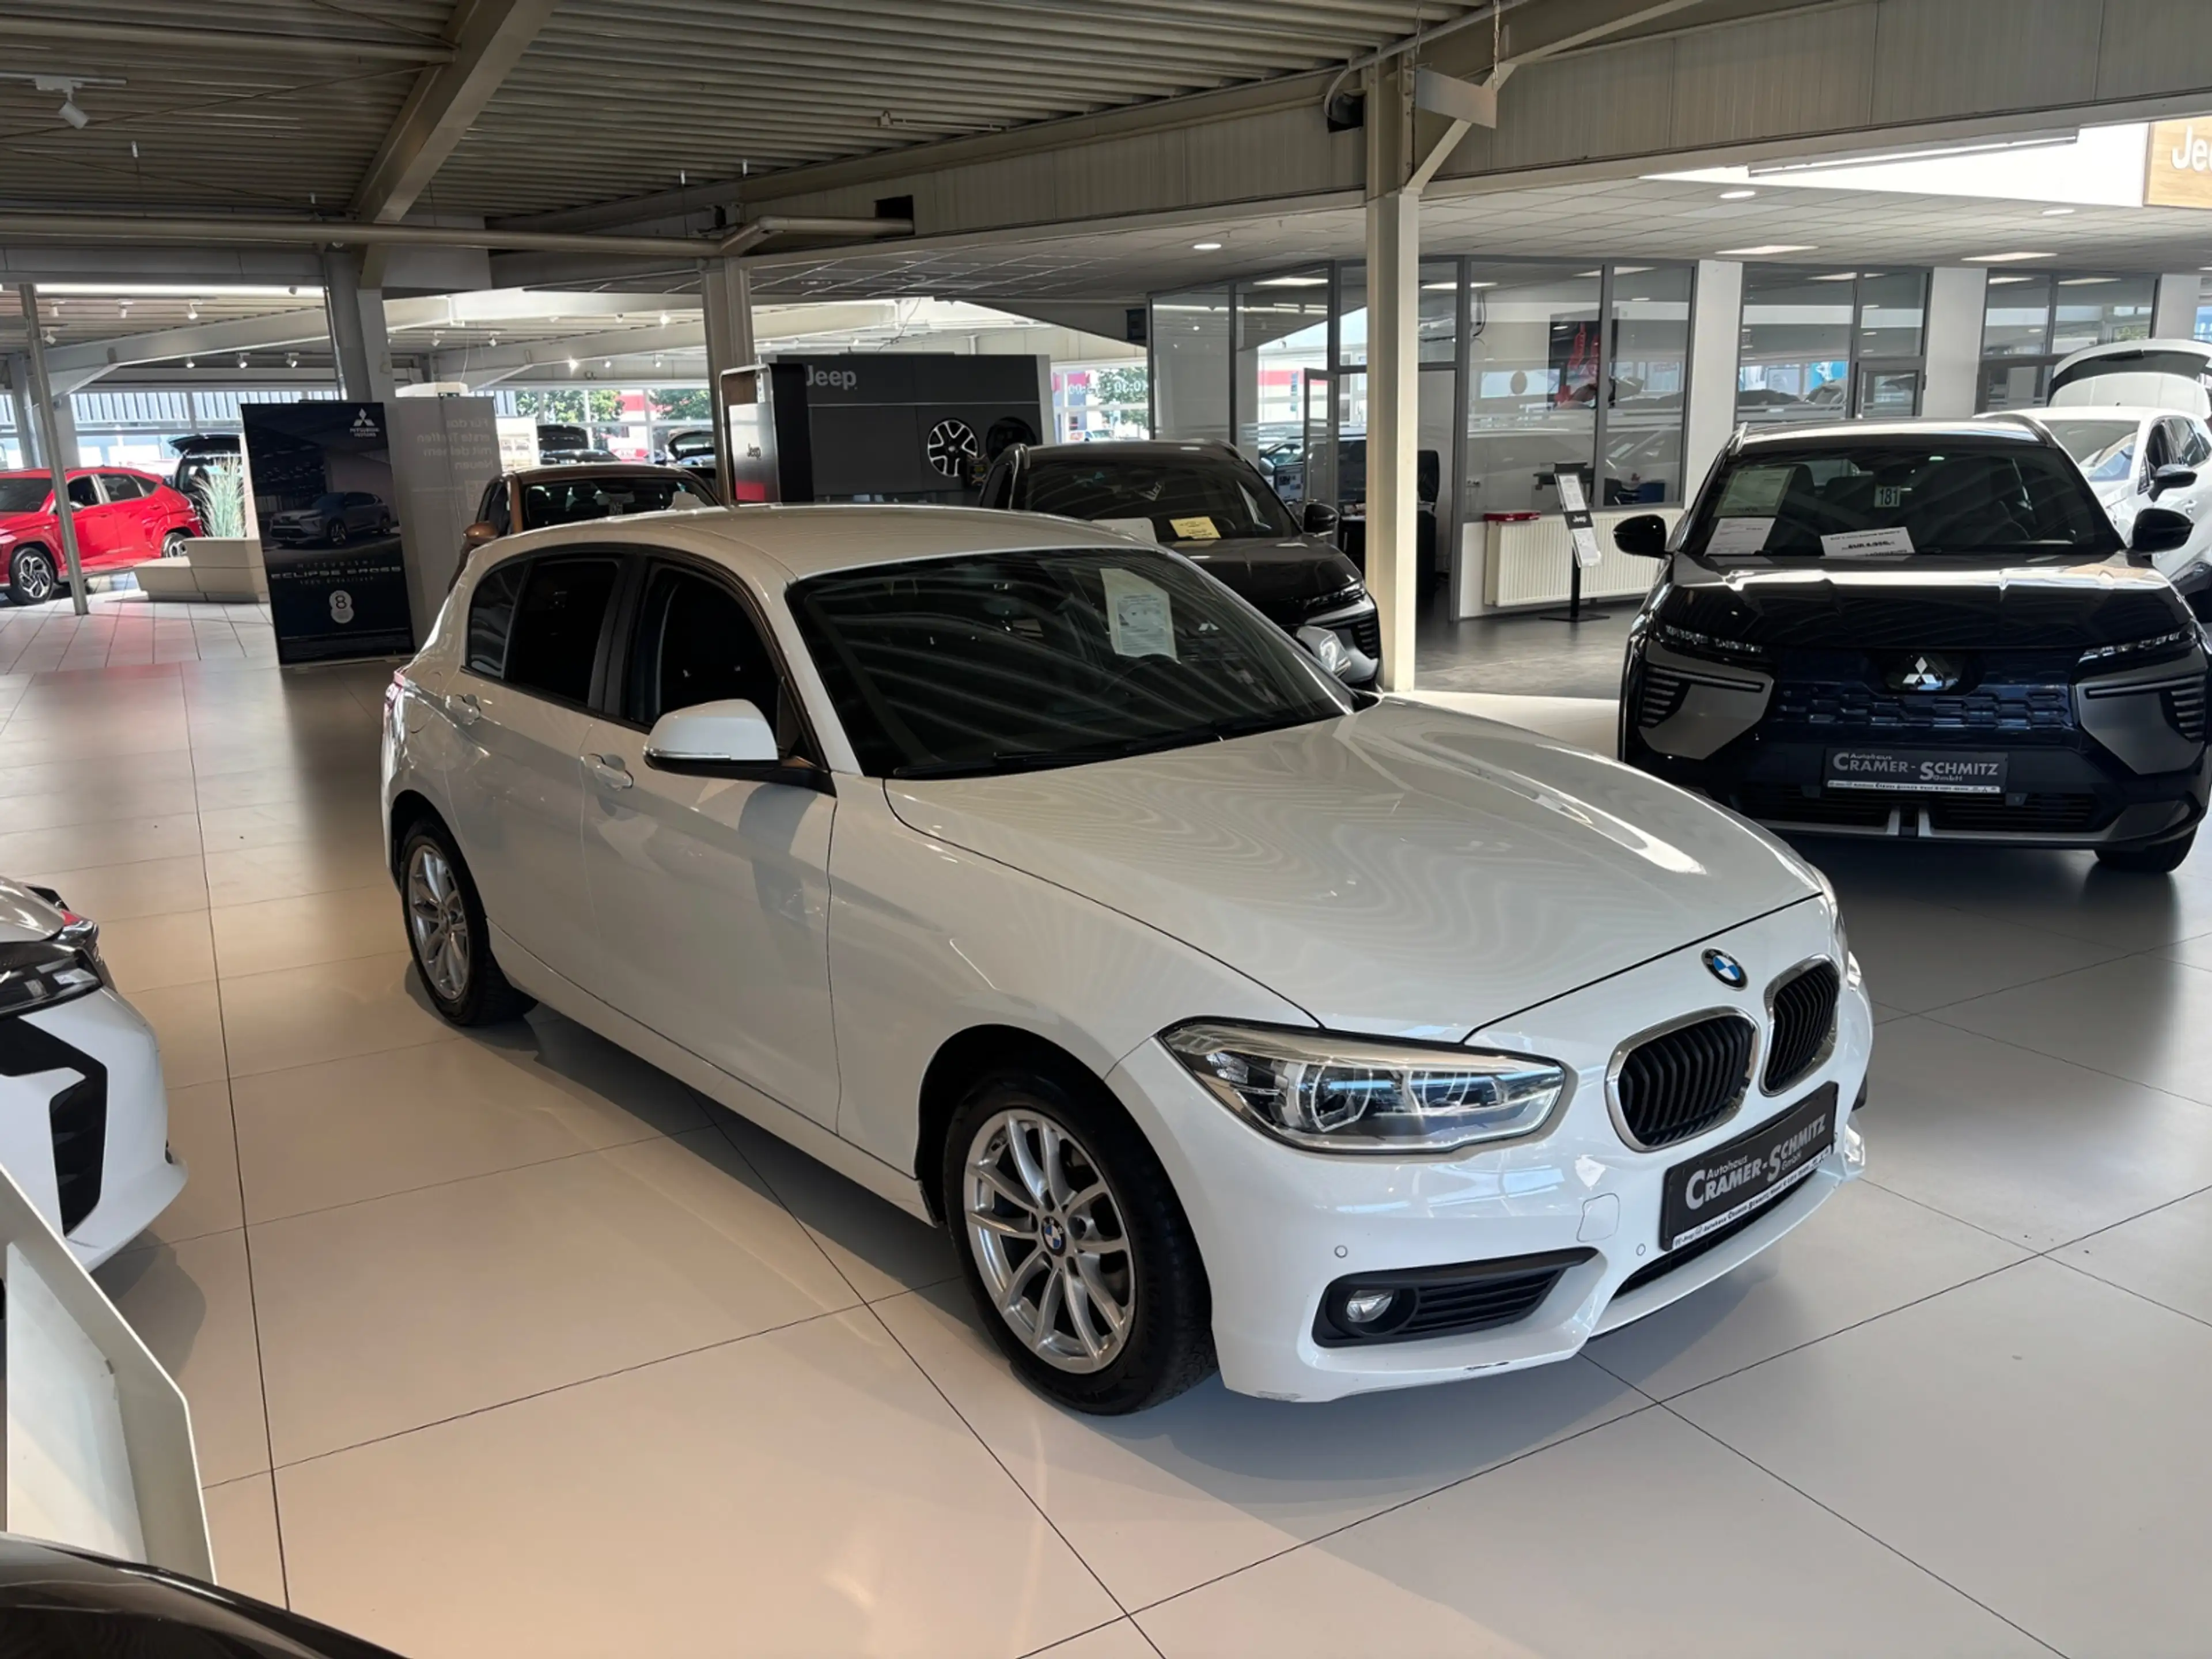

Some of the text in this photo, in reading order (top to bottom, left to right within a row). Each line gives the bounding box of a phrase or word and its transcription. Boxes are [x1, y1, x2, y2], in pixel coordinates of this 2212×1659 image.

[2172, 124, 2212, 172] Je
[806, 365, 857, 391] Jeep
[747, 443, 762, 460] Jeep
[1880, 488, 1898, 505] 181
[335, 595, 347, 609] 8
[1706, 1154, 1748, 1180] Autohaus
